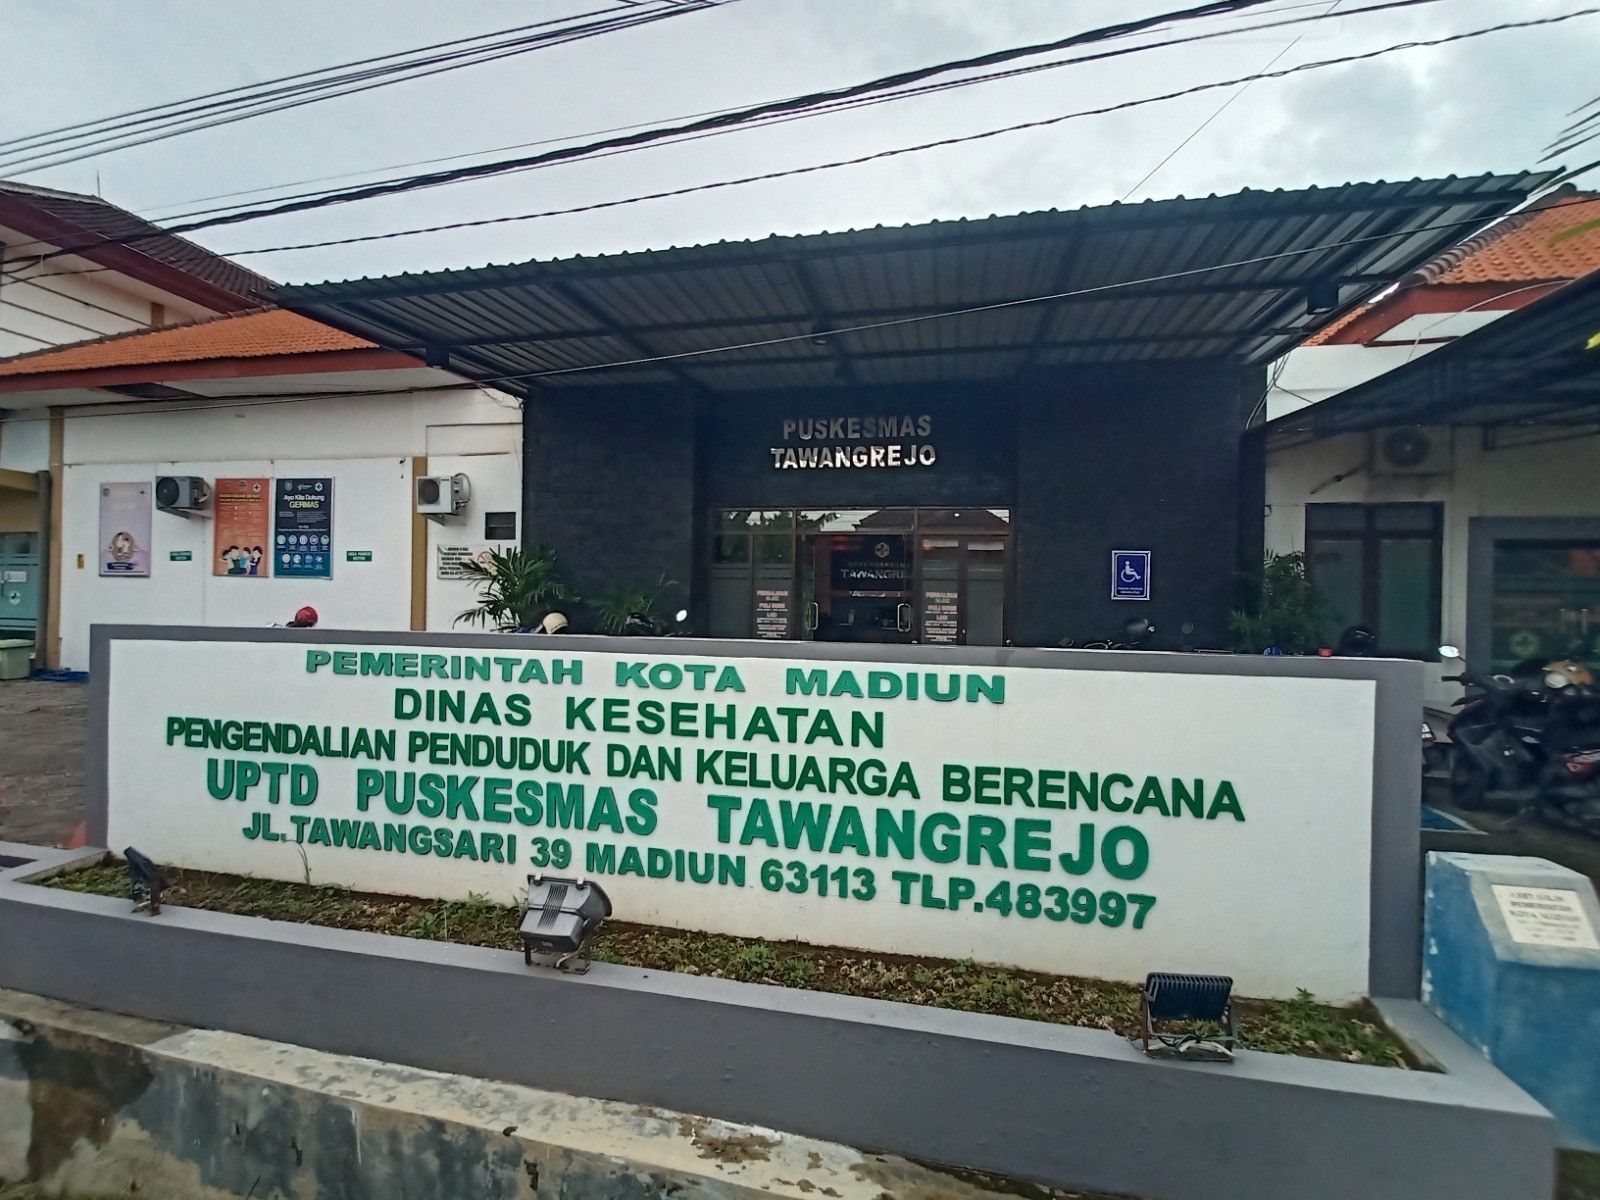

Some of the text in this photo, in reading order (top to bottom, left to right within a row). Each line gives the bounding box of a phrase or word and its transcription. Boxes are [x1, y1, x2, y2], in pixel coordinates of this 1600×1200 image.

[782, 415, 932, 441] PUSKESMAS
[770, 444, 937, 470] TAWANGREJO
[283, 494, 295, 502] Ayo
[305, 494, 325, 502] Dukung
[289, 501, 320, 509] GERMAS
[840, 568, 911, 579] TAWANGRE
[306, 650, 1006, 705] PEMERINTAH KOTA MADIUN
[395, 688, 884, 749] DINAS KESEHATAN
[167, 717, 1246, 823] PENGENDALIAN PENDUDUK DAN KELUARGA BERENCANA
[207, 758, 1150, 882] UPTD PUSKESMAS TAWANGREJO
[530, 837, 572, 871] 39
[586, 842, 746, 888] MADIUN
[761, 859, 877, 902] 63113
[892, 871, 1157, 930] TLP.483997
